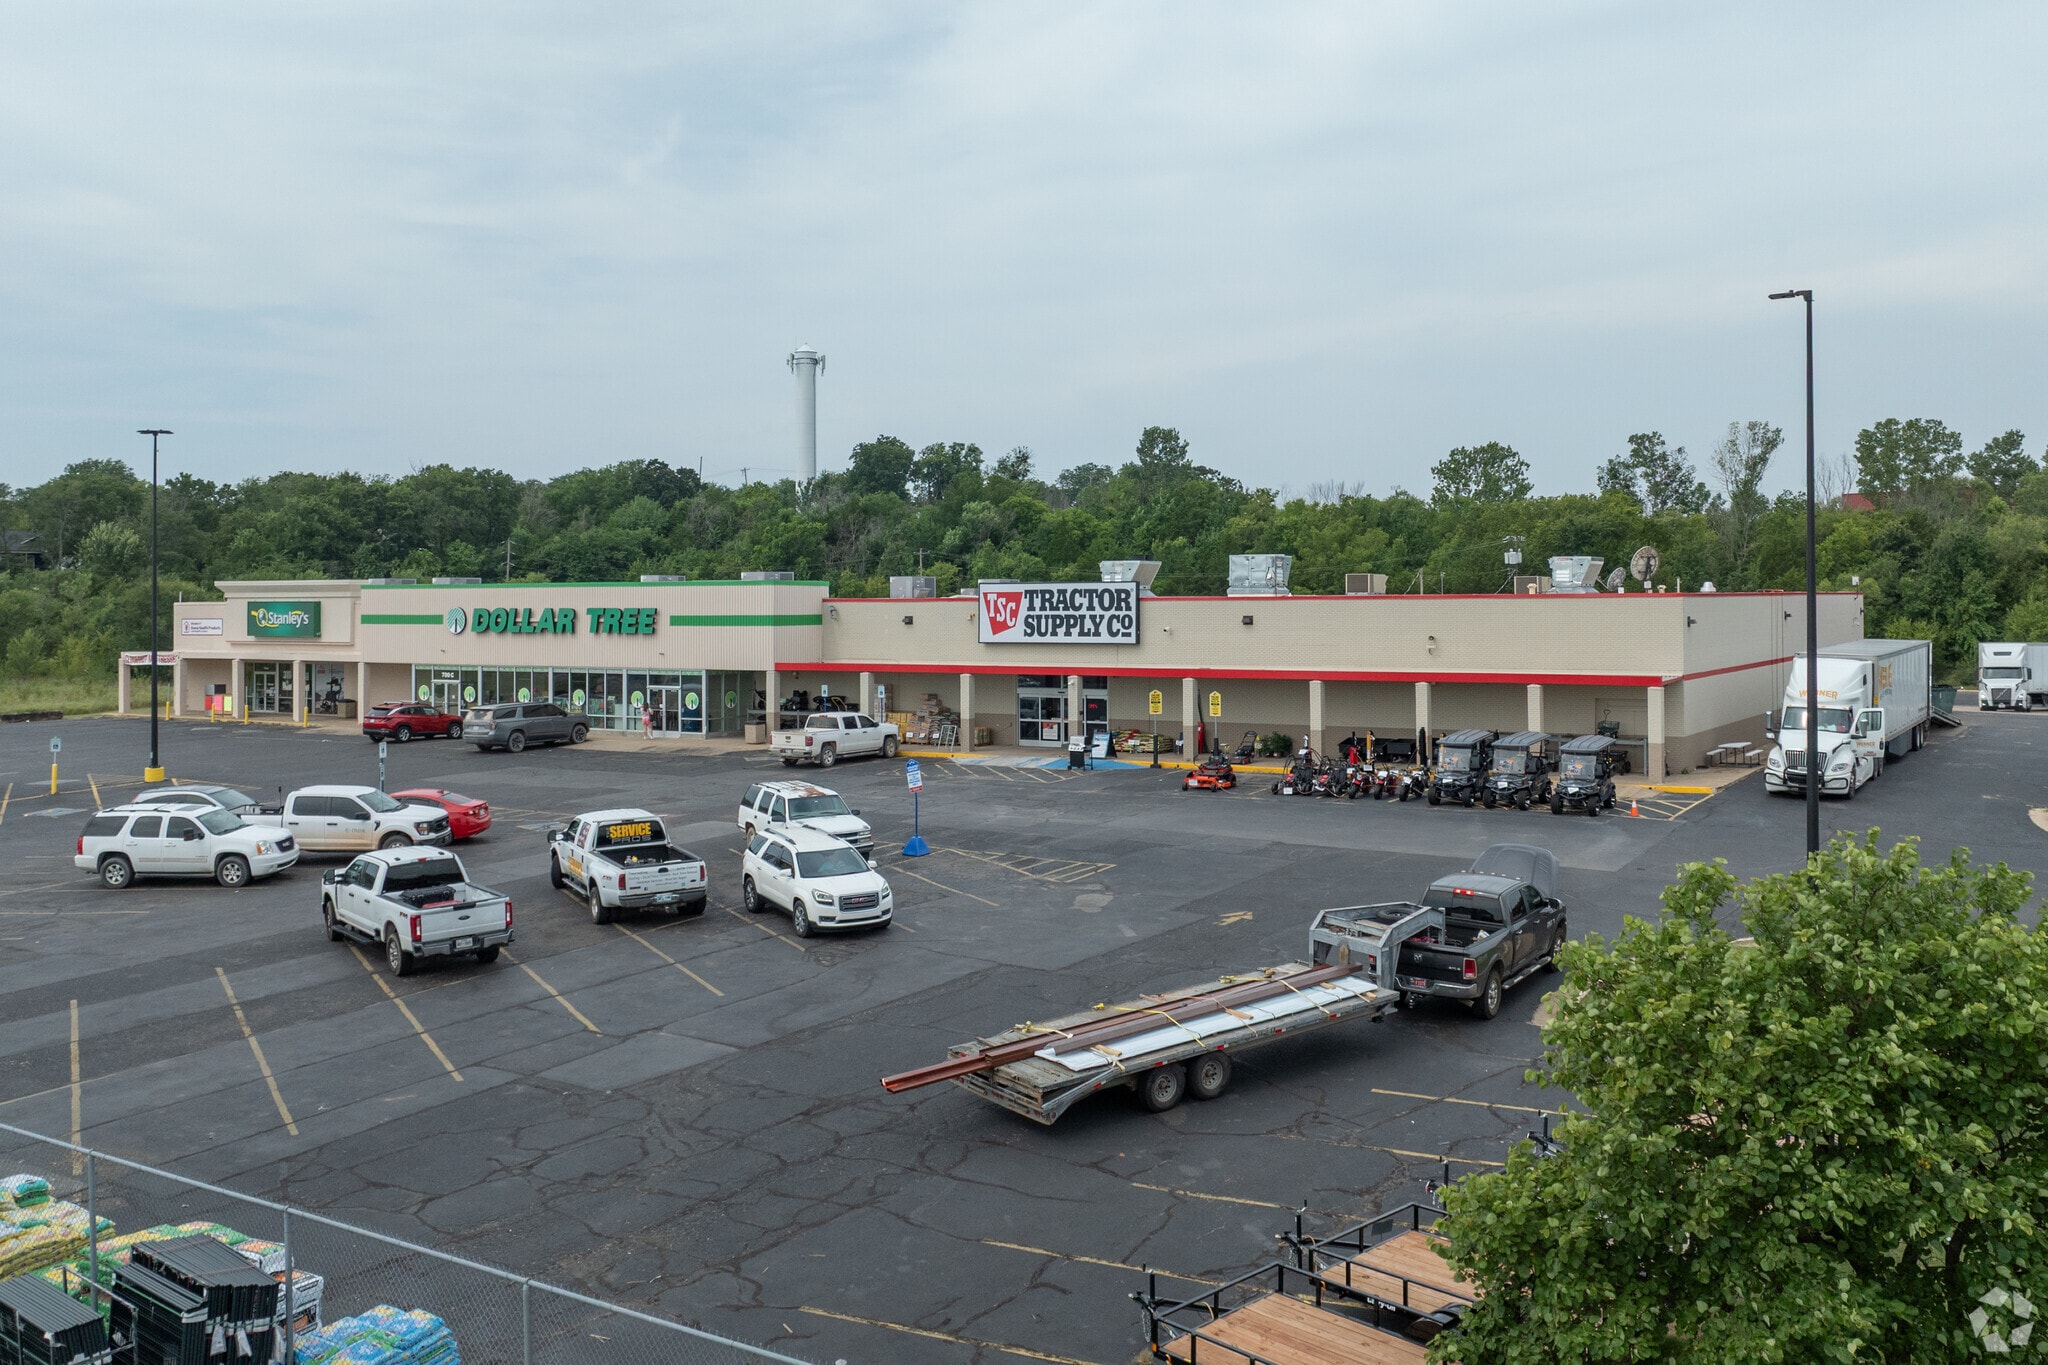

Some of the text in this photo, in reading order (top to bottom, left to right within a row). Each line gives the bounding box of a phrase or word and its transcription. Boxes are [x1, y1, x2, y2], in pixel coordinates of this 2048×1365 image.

[987, 593, 1016, 627] TSC
[1024, 588, 1132, 612] TRACTOR
[268, 611, 309, 628] Stanley's
[471, 607, 657, 635] DOLLAR TREE
[1023, 614, 1105, 637] SUPPLY
[1799, 690, 1838, 700] WNER
[610, 822, 651, 838] SERVICE
[611, 835, 651, 844] PROS
